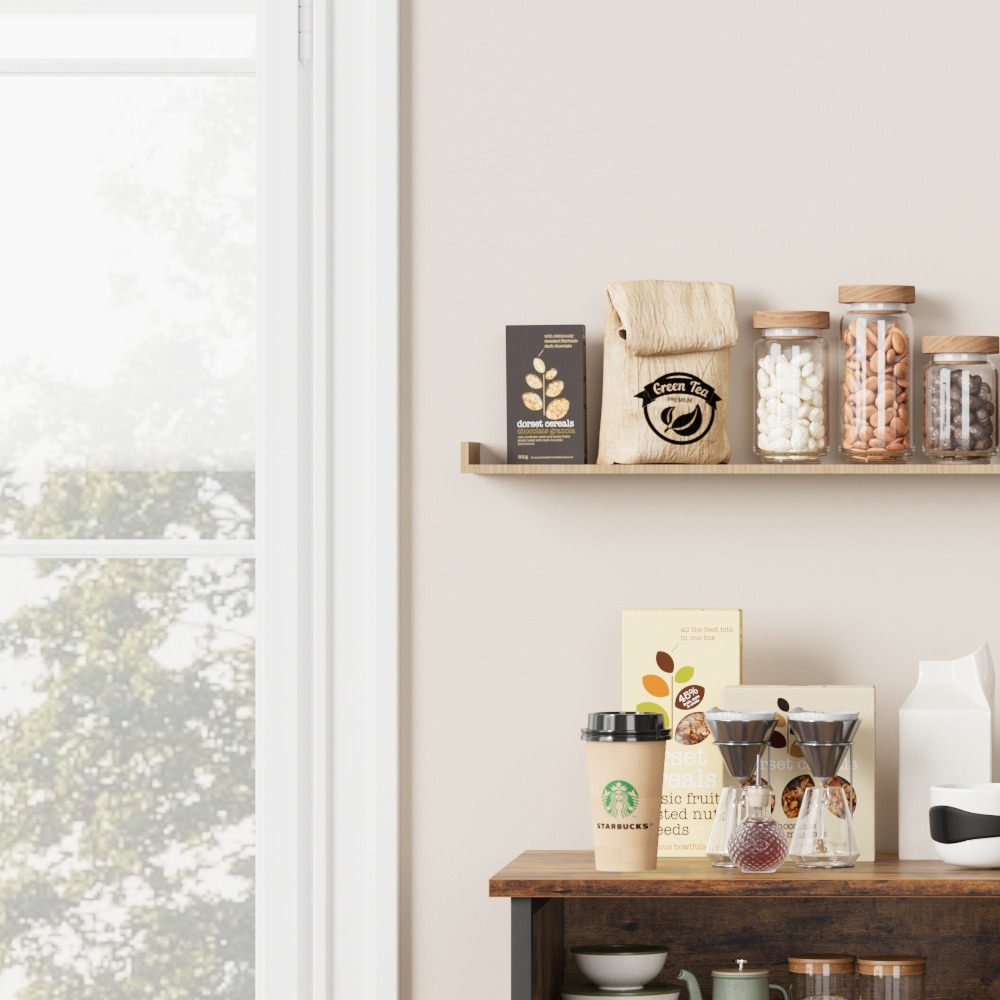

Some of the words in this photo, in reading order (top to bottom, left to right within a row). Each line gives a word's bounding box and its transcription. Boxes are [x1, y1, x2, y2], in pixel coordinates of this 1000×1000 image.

[652, 382, 686, 395] Green
[689, 380, 709, 398] Tea
[516, 420, 544, 428] dorset
[544, 419, 575, 428] cereals
